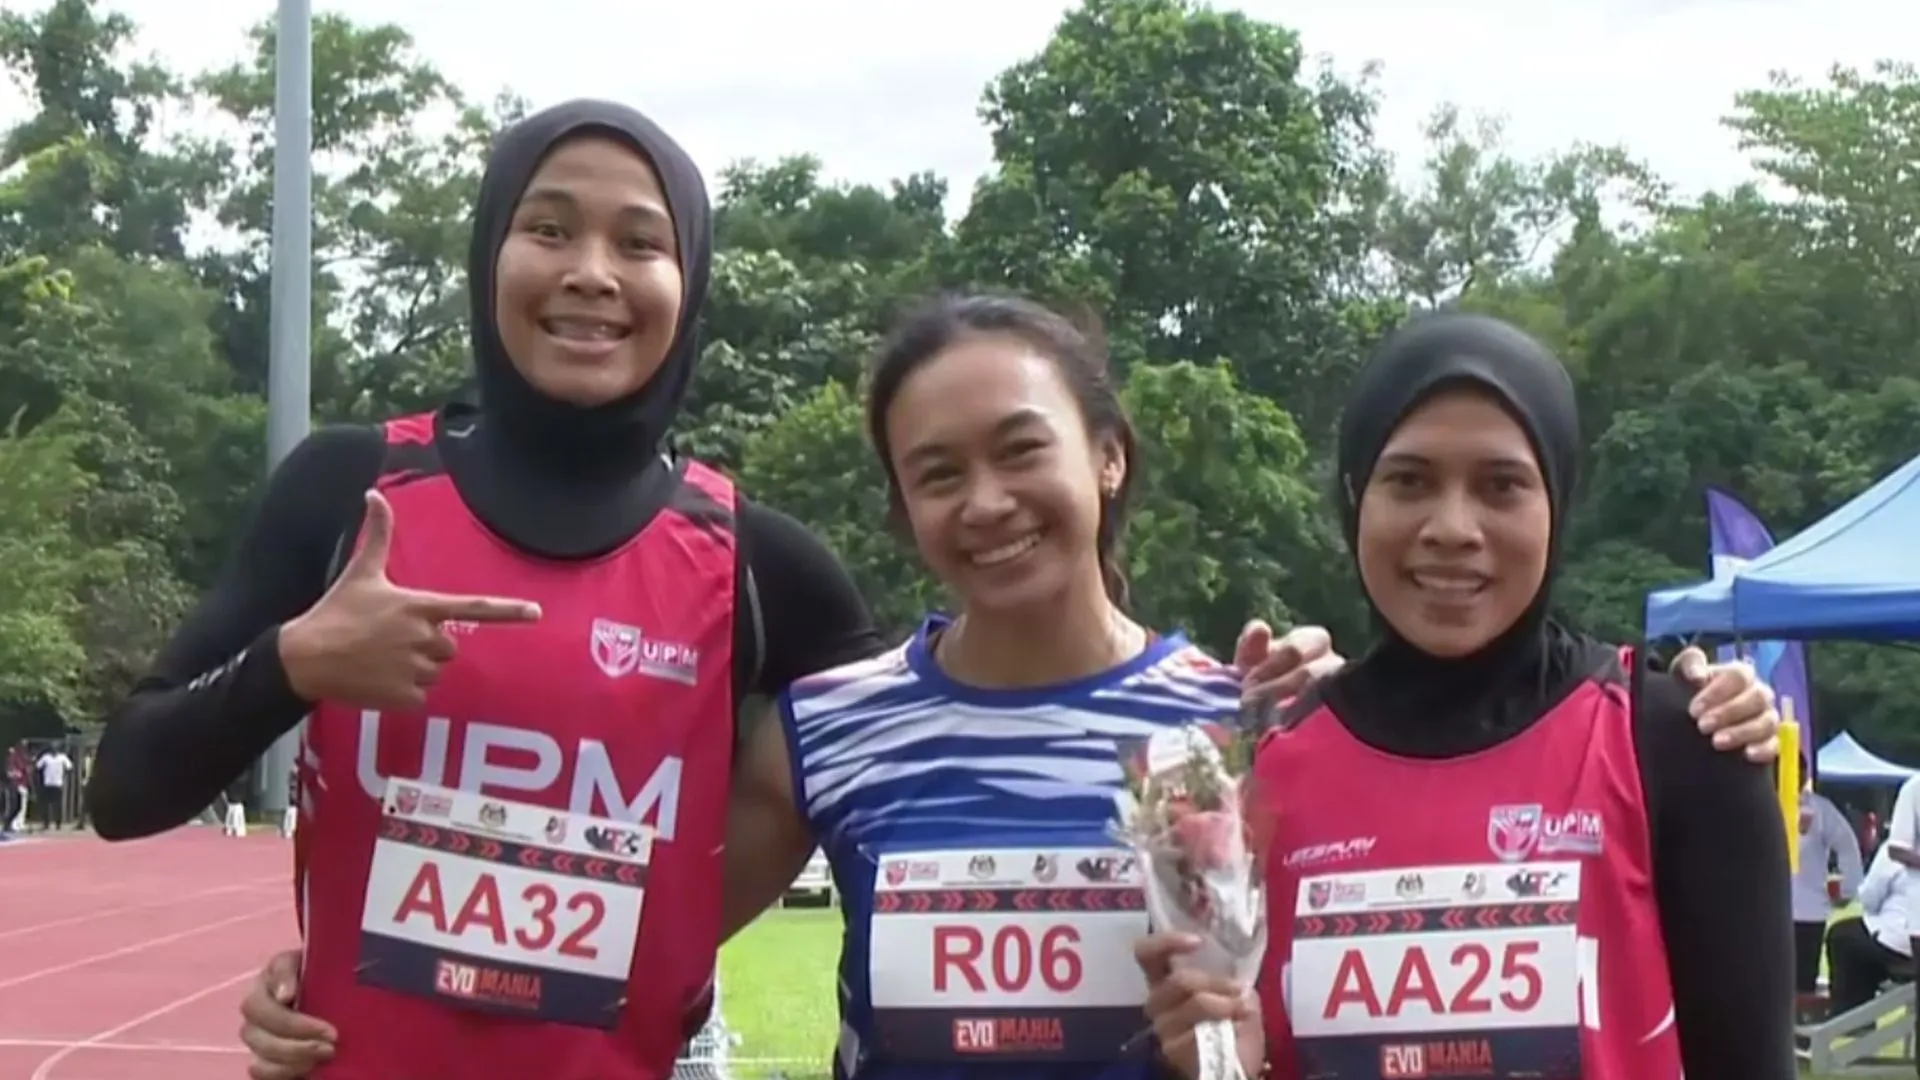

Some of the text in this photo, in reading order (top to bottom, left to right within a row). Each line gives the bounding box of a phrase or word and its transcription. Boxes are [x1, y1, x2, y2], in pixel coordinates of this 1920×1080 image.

[643, 641, 698, 666] UPM
[356, 709, 684, 842] UPM
[1545, 812, 1601, 837] UPM
[392, 861, 606, 960] AA32
[932, 924, 1083, 993] R06
[1322, 941, 1543, 1020] AA25
